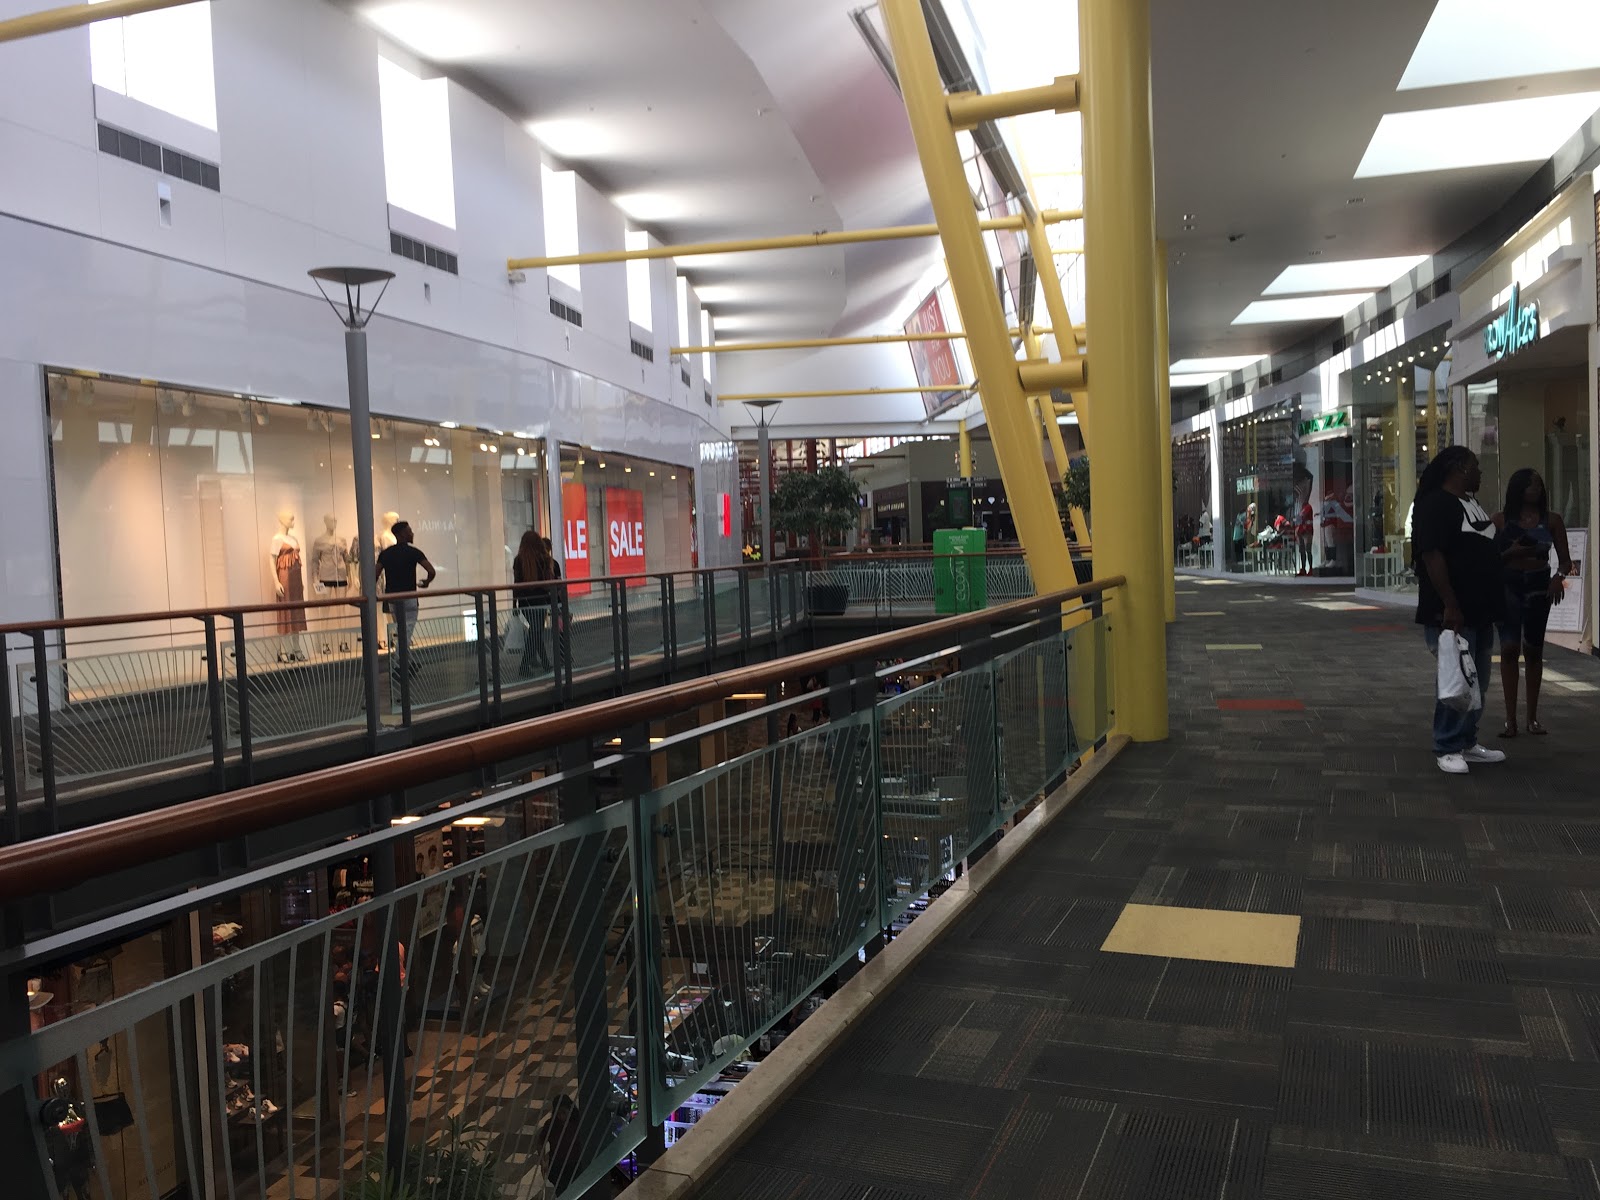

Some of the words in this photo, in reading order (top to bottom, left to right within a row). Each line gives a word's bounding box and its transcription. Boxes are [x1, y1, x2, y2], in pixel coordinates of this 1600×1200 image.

[922, 300, 940, 333] JUST
[932, 352, 951, 384] YOU
[610, 520, 644, 557] SALE
